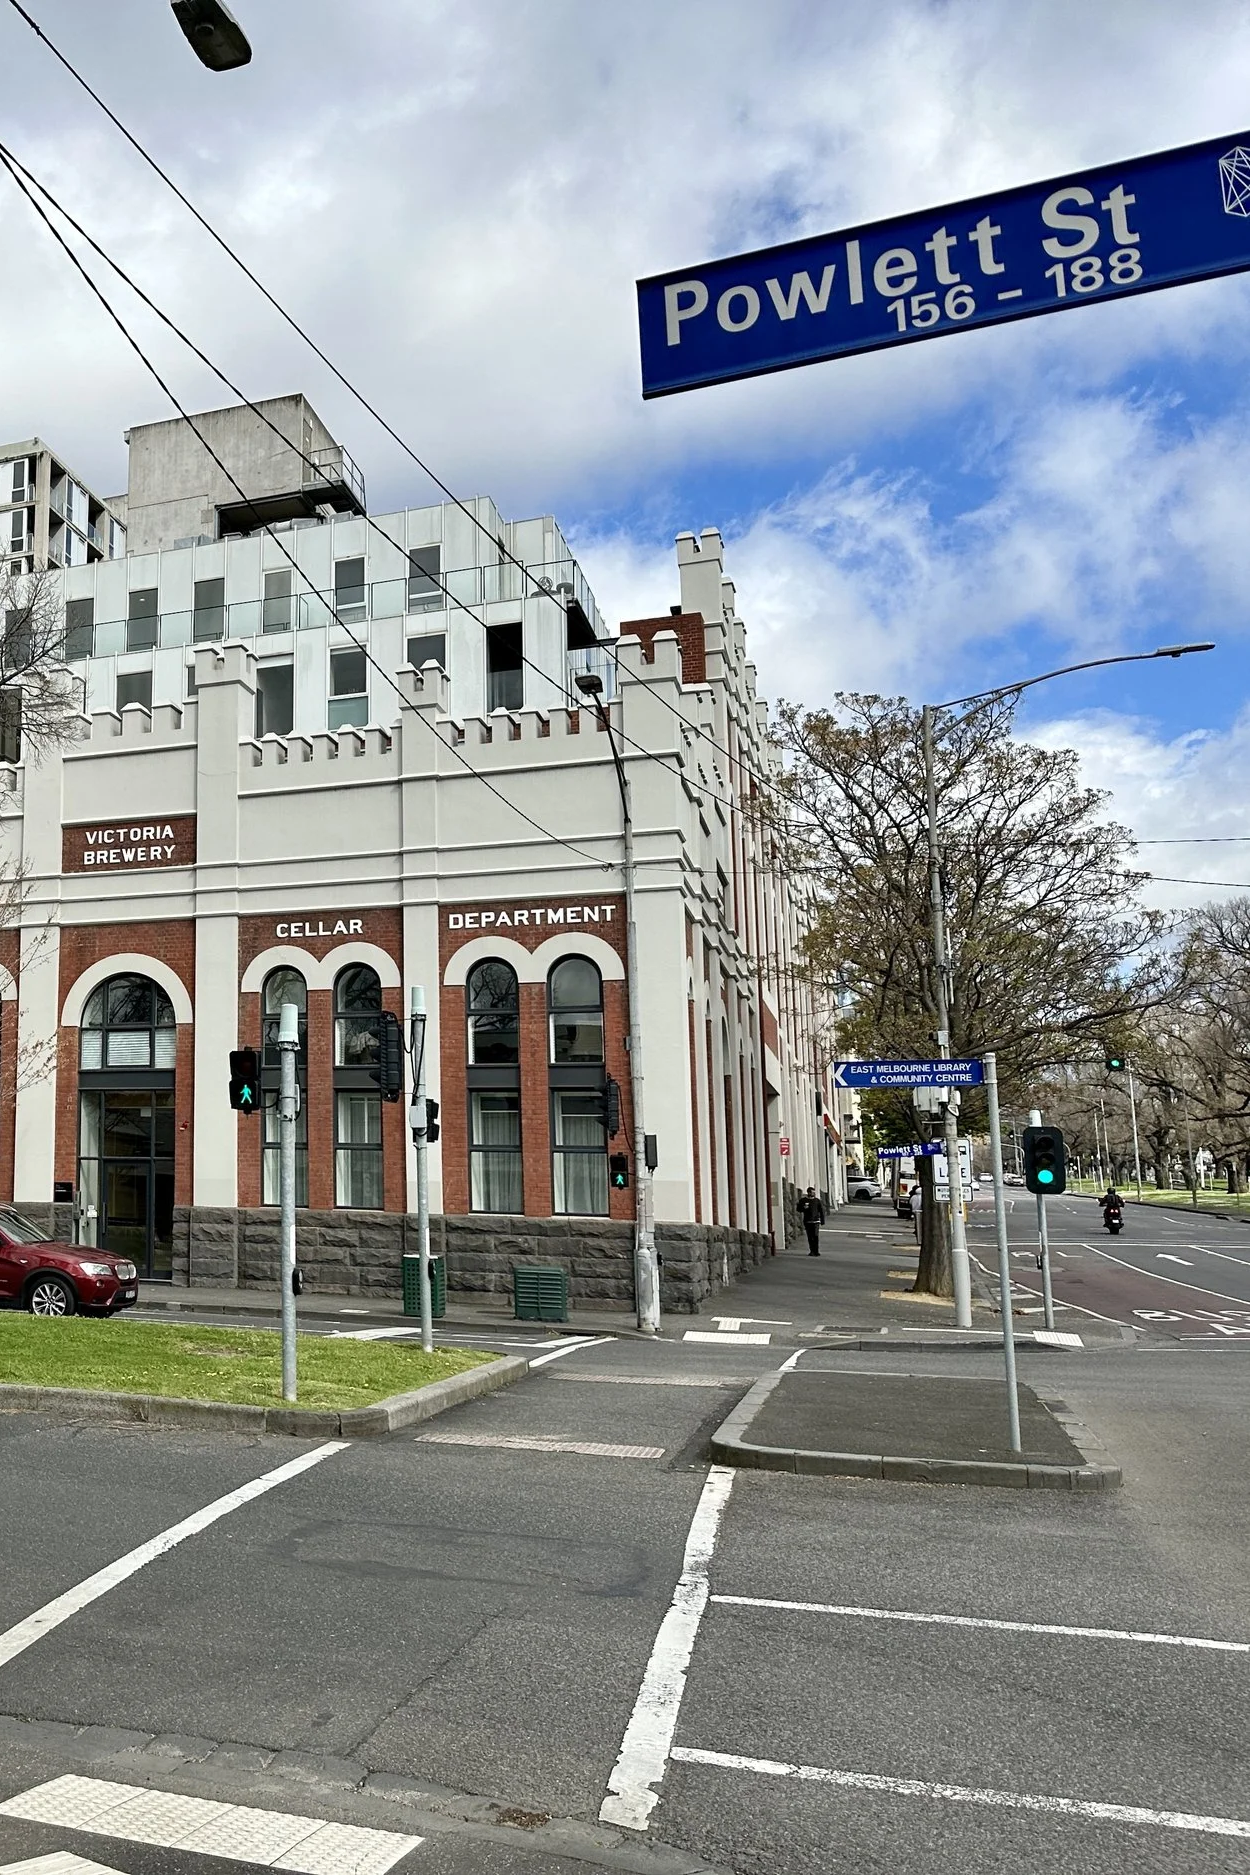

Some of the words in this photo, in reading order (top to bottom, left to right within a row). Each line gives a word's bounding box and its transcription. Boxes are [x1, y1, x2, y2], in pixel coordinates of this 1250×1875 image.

[664, 215, 1006, 347] Powlett
[1040, 183, 1141, 260] St
[886, 284, 977, 333] 156
[1044, 247, 1144, 299] 188
[85, 824, 175, 845] VICTORIA
[83, 844, 176, 865] BREWERY
[276, 918, 364, 938] CELLAR
[449, 904, 617, 930] DEPARTMENT
[850, 1065, 874, 1074] EAST
[876, 1064, 931, 1073] MELBOURNE
[933, 1063, 972, 1072] LIBRARY
[870, 1075, 878, 1084] &
[879, 1075, 933, 1084] COMMUNITY
[935, 1073, 972, 1082] CENTRE
[878, 1147, 911, 1155] Powlett
[912, 1144, 922, 1152] St
[939, 1168, 966, 1178] LE
